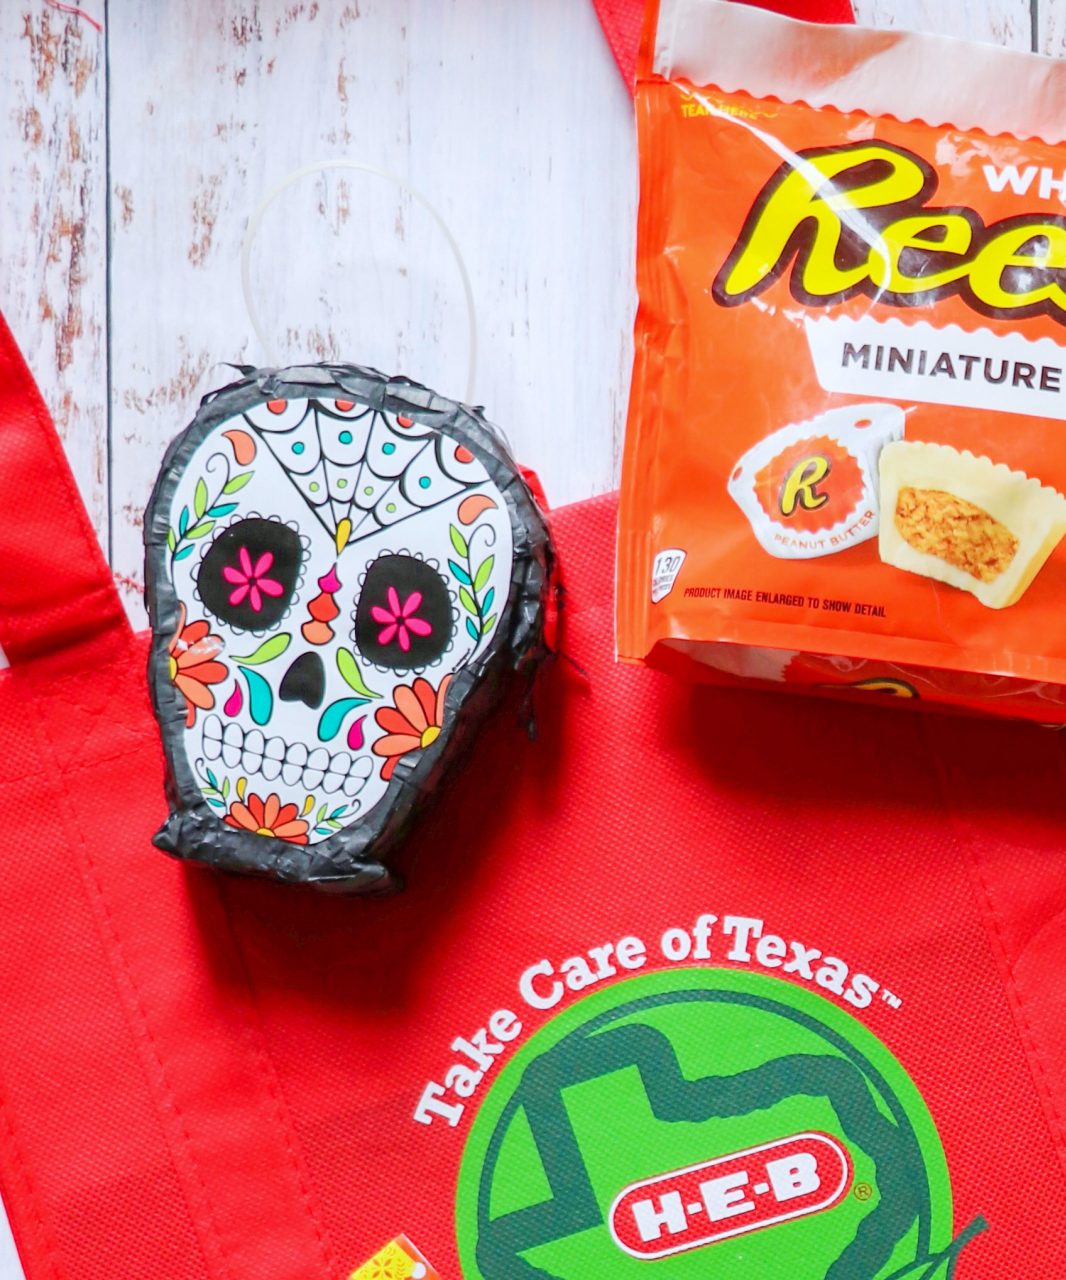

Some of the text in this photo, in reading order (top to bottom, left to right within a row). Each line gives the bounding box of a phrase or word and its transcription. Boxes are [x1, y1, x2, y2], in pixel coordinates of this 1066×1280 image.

[841, 342, 1062, 394] MINIATURE
[774, 510, 876, 550] PEANUT BUTTER
[684, 587, 887, 618] PRODUCT IMAGE ENLARGED TO SHOW DETAIL
[413, 1007, 524, 1128] Take
[518, 931, 647, 1011] Care
[660, 914, 716, 962] of
[629, 1151, 822, 1243] H-E-B
